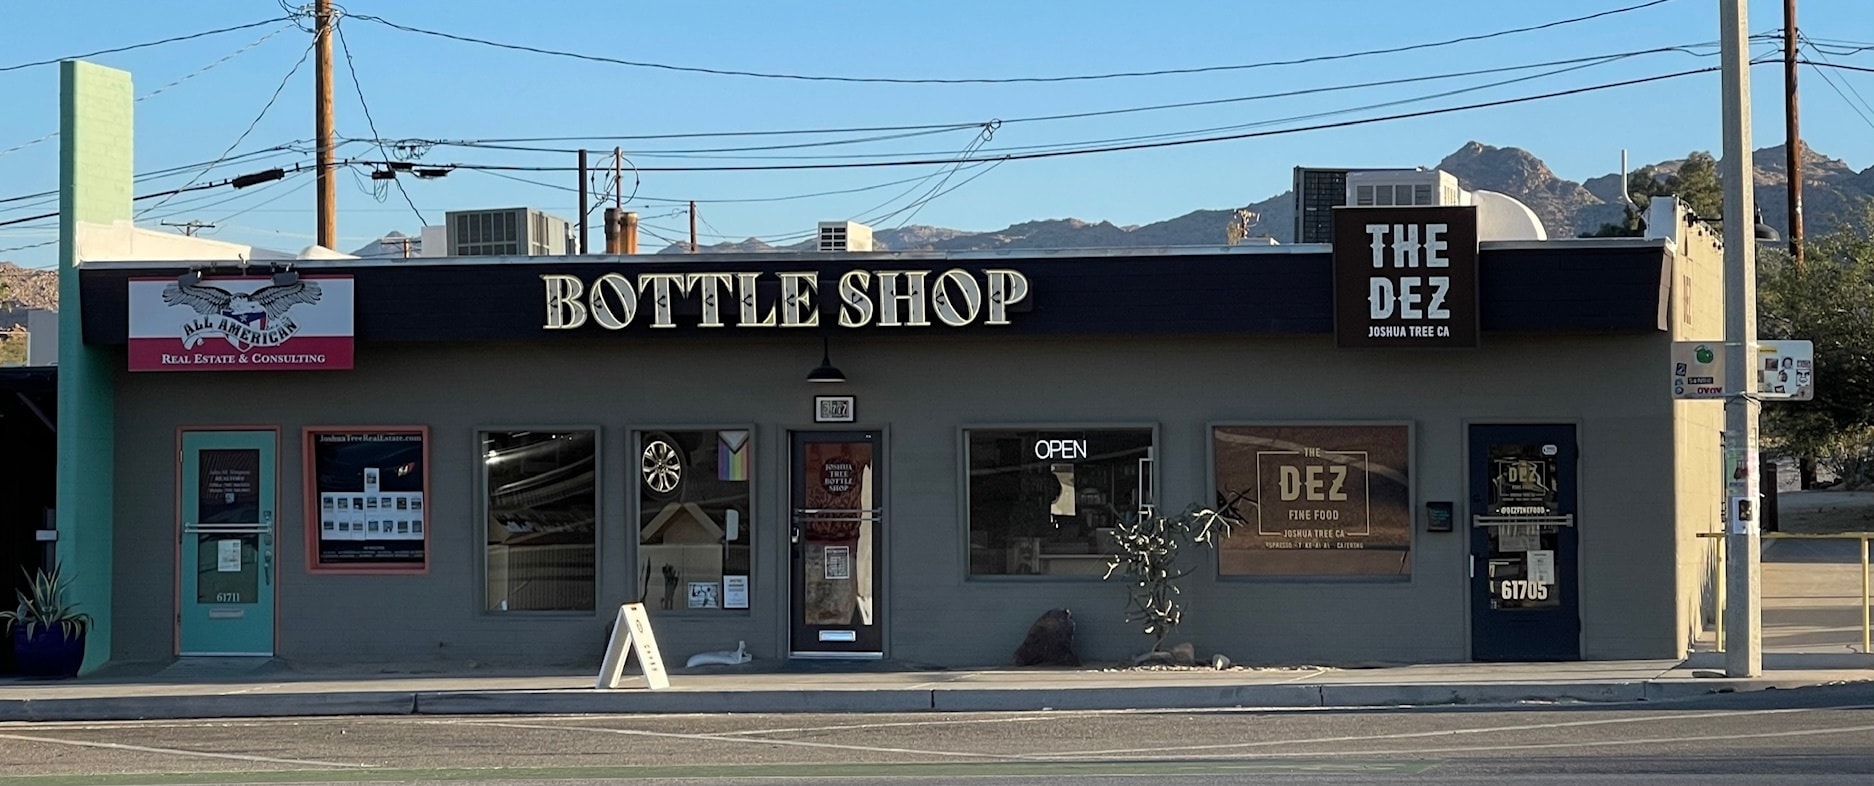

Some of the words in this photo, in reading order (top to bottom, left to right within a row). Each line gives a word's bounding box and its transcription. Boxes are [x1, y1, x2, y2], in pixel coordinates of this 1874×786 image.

[1365, 223, 1449, 268] THE
[540, 271, 819, 330] BOTTLE
[838, 267, 1029, 327] SHOP
[1367, 276, 1450, 320] DEZ
[183, 316, 213, 336] ALL
[217, 317, 297, 345] AMERICAN
[1368, 325, 1406, 337] JOSHUA
[1409, 325, 1434, 337] TREE
[1437, 325, 1450, 337] CA
[162, 354, 190, 364] REAL
[194, 354, 236, 364] ESTATE
[239, 353, 248, 364] &
[252, 353, 326, 364] CONSULTING
[1035, 440, 1087, 459] OPEN
[1303, 447, 1321, 457] THE
[1278, 465, 1348, 501] DEZ
[1288, 510, 1311, 520] FINE
[1314, 510, 1339, 520] FOOD
[1284, 529, 1312, 538] JOSHUA
[1315, 529, 1333, 538] TREE
[1335, 529, 1345, 538] CA
[217, 593, 240, 602] 61711
[1501, 580, 1548, 600] 61705
